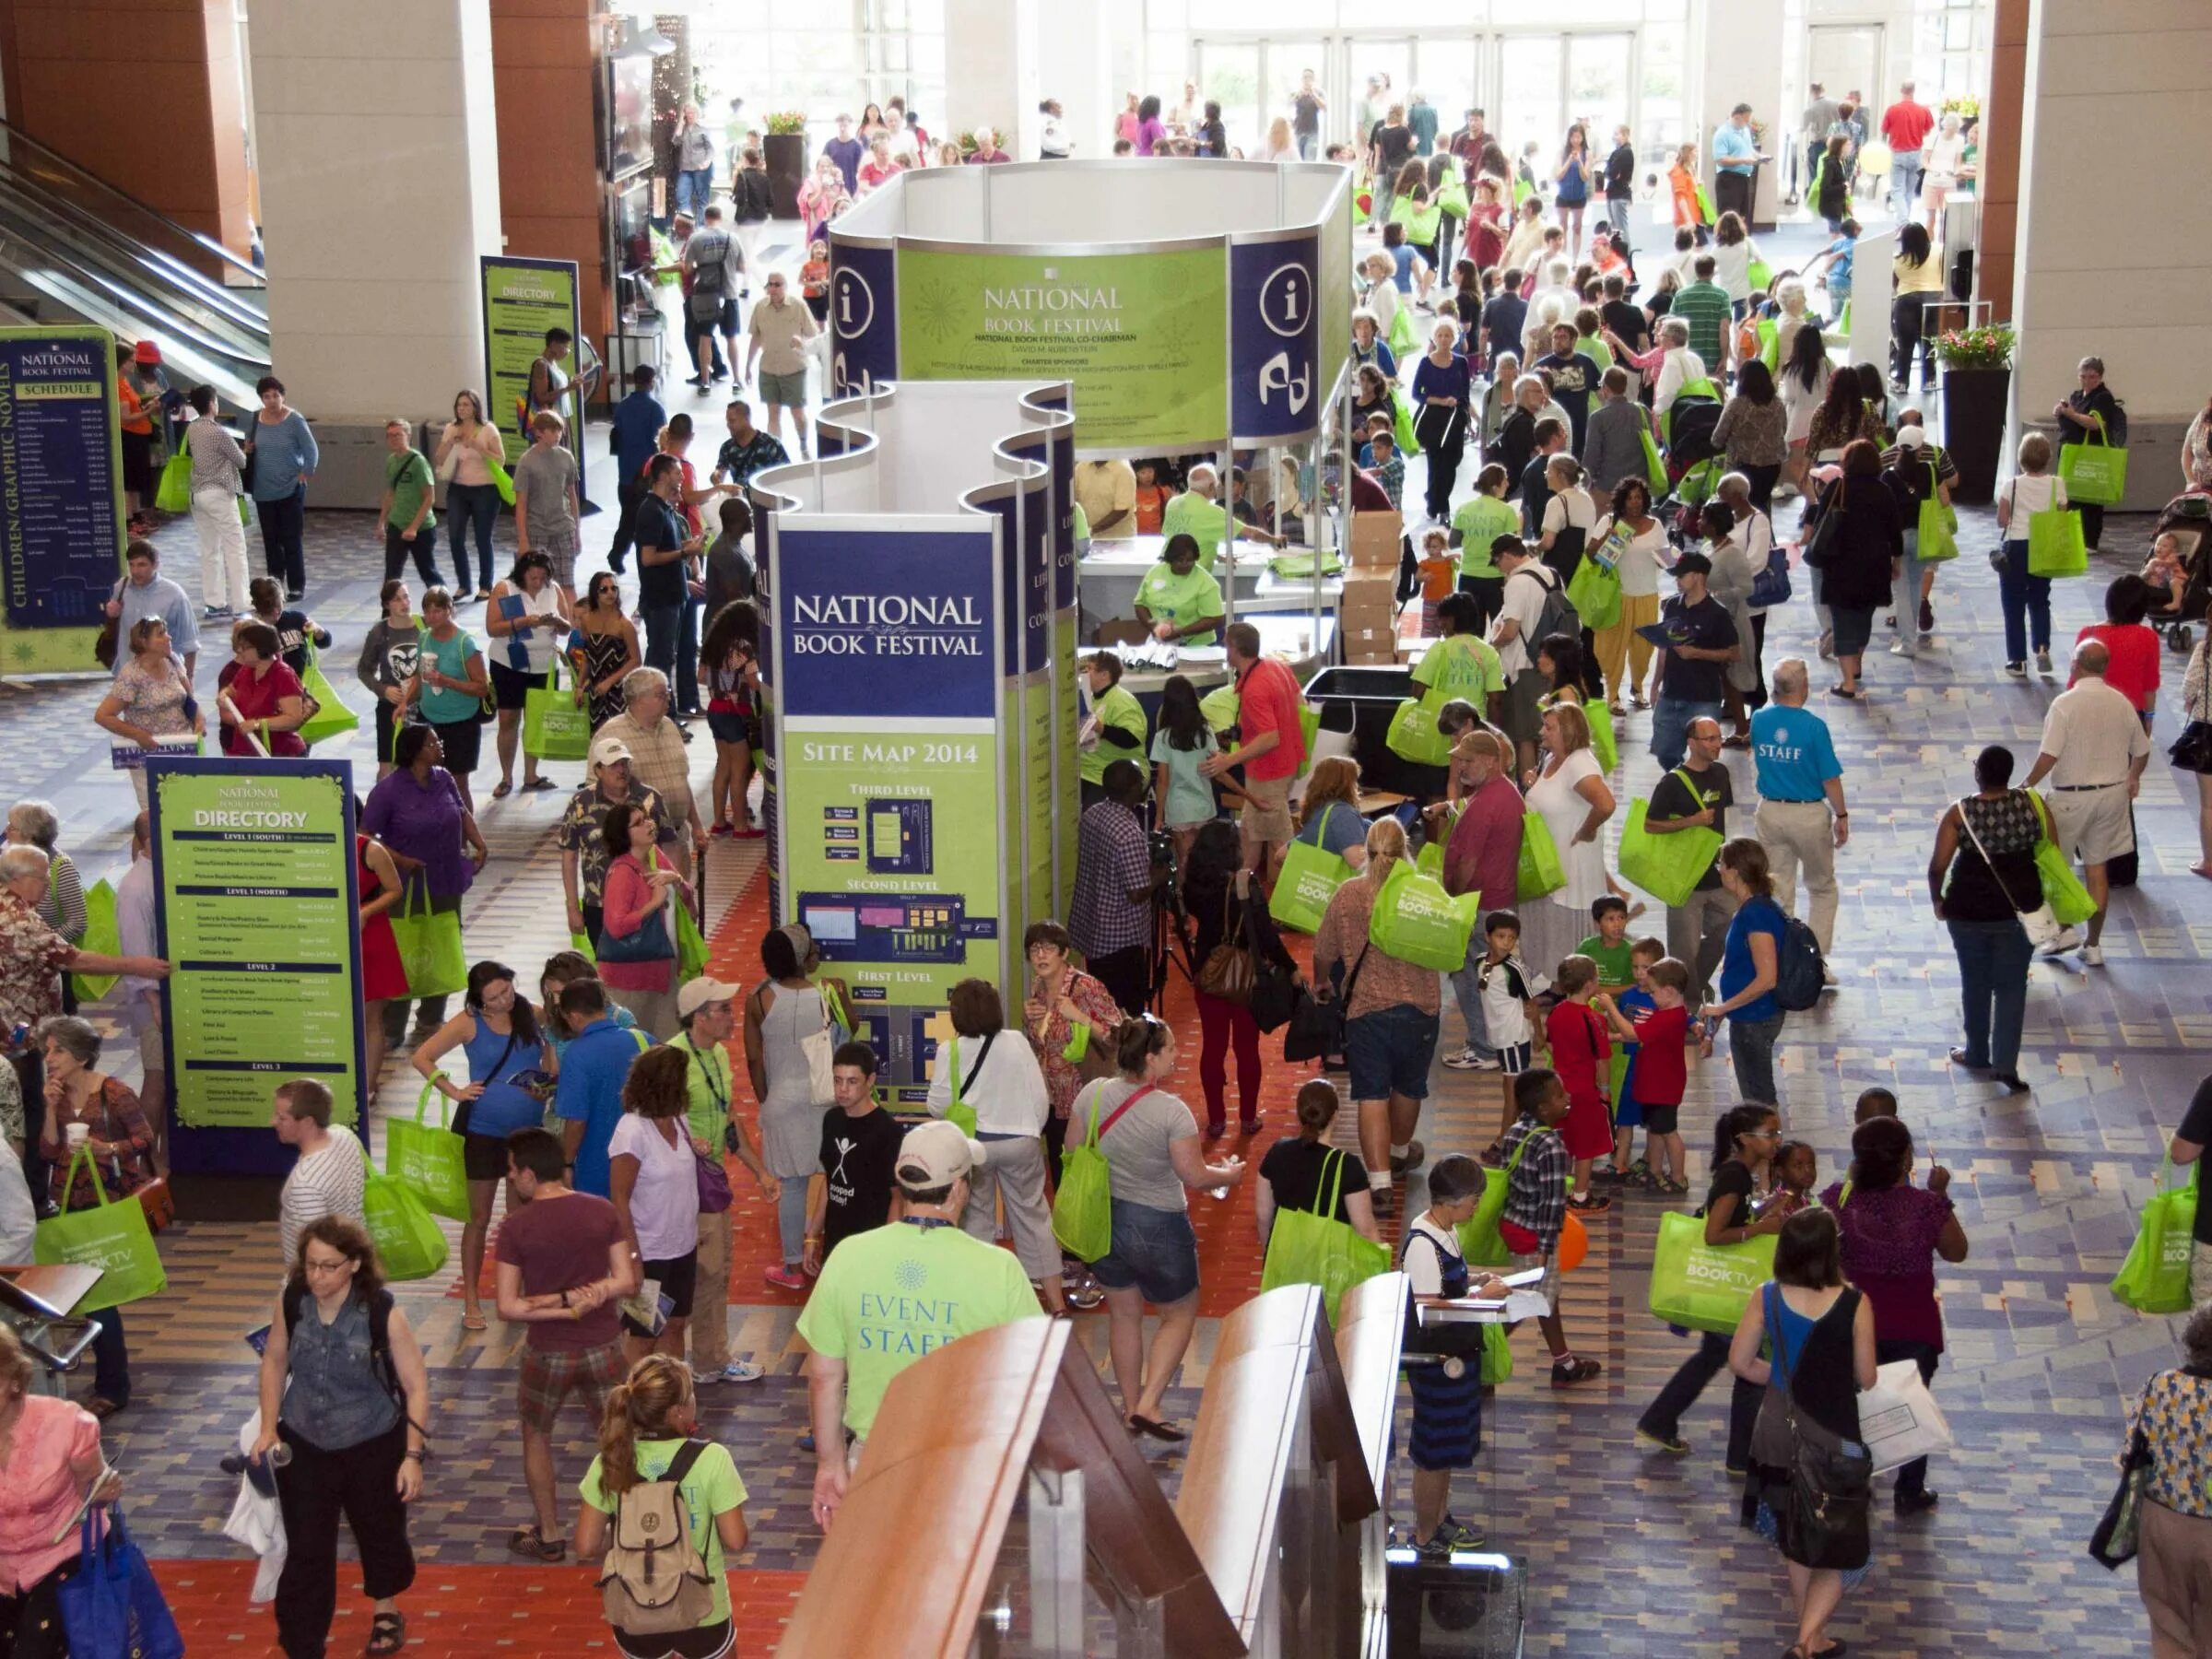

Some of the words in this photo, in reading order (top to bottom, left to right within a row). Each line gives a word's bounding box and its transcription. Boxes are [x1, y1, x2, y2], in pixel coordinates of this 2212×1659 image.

[502, 287, 556, 300] DIRECTORY
[984, 288, 1123, 311] NATIONAL
[984, 318, 1036, 334] BOOK
[1044, 317, 1123, 334] FESTIVAL
[975, 335, 1014, 343] NATIONAL
[1077, 334, 1136, 343] CO-CHAIRMAN
[1012, 346, 1036, 354] DAVID
[22, 354, 93, 366] NATIONAL
[22, 368, 50, 377] BOOK
[53, 367, 93, 376] FESTIVAL
[0, 362, 14, 429] NOVELS
[24, 383, 93, 395] SCHEDULE
[793, 595, 982, 627] NATIONAL
[794, 634, 867, 654] BOOK
[876, 635, 982, 656] FESTIVAL
[803, 742, 854, 762] SITE
[863, 744, 916, 763] MAP
[923, 744, 979, 763] 2014
[1759, 744, 1803, 760] STAFF
[218, 788, 280, 799] NATIONAL
[849, 783, 892, 795] THIRD
[896, 785, 934, 796] LEVEL
[194, 810, 308, 828] DIRECTORY
[224, 832, 245, 841] LEVEL
[253, 832, 286, 841] (SOUTH)
[847, 878, 900, 890] SECOND
[902, 880, 940, 891] LEVEL
[227, 888, 248, 896] LEVEL
[255, 888, 288, 897] (NORTH)
[1297, 885, 1330, 903] BOOK
[1397, 899, 1431, 917] BOOK
[857, 971, 894, 982] FIRST
[896, 971, 934, 982] LEVEL
[1686, 1263, 1734, 1283] BOOK
[1735, 1271, 1756, 1286] TV
[859, 1293, 959, 1324] EVENT
